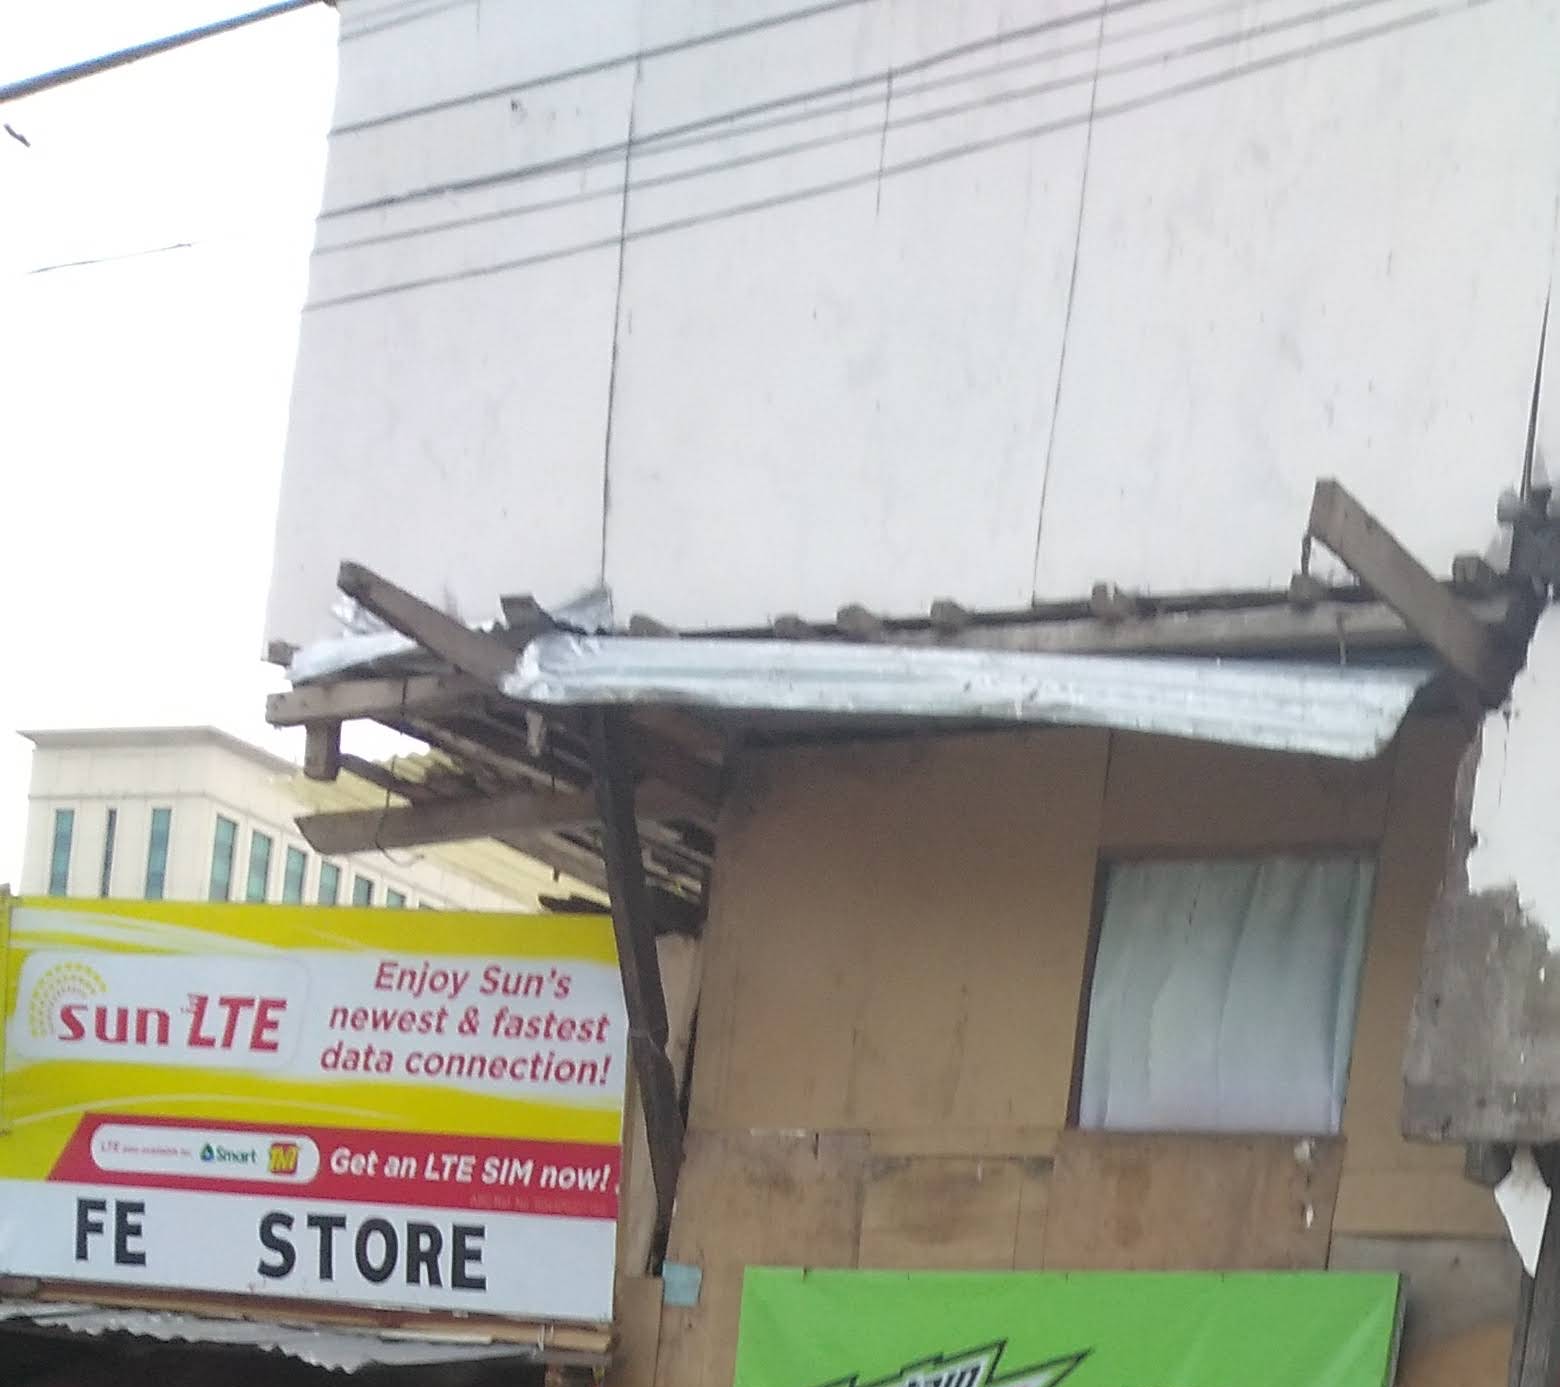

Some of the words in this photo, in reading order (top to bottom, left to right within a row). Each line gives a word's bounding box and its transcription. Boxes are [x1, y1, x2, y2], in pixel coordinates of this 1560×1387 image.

[374, 961, 471, 999] Enjoy
[479, 965, 572, 999] Sun's
[58, 1003, 171, 1046] sun
[186, 994, 288, 1052] LTE
[329, 1003, 447, 1035] newest
[457, 1006, 479, 1034] &
[491, 1008, 611, 1044] fastest
[320, 1040, 393, 1074] data
[405, 1049, 612, 1086] connection!
[216, 1146, 257, 1163] Smart
[330, 1147, 378, 1177] Get
[384, 1156, 418, 1180] an
[424, 1152, 477, 1184] LTE
[482, 1156, 534, 1187] SIM
[540, 1163, 610, 1193] now!
[75, 1198, 146, 1266] FE
[258, 1212, 487, 1291] STORE
